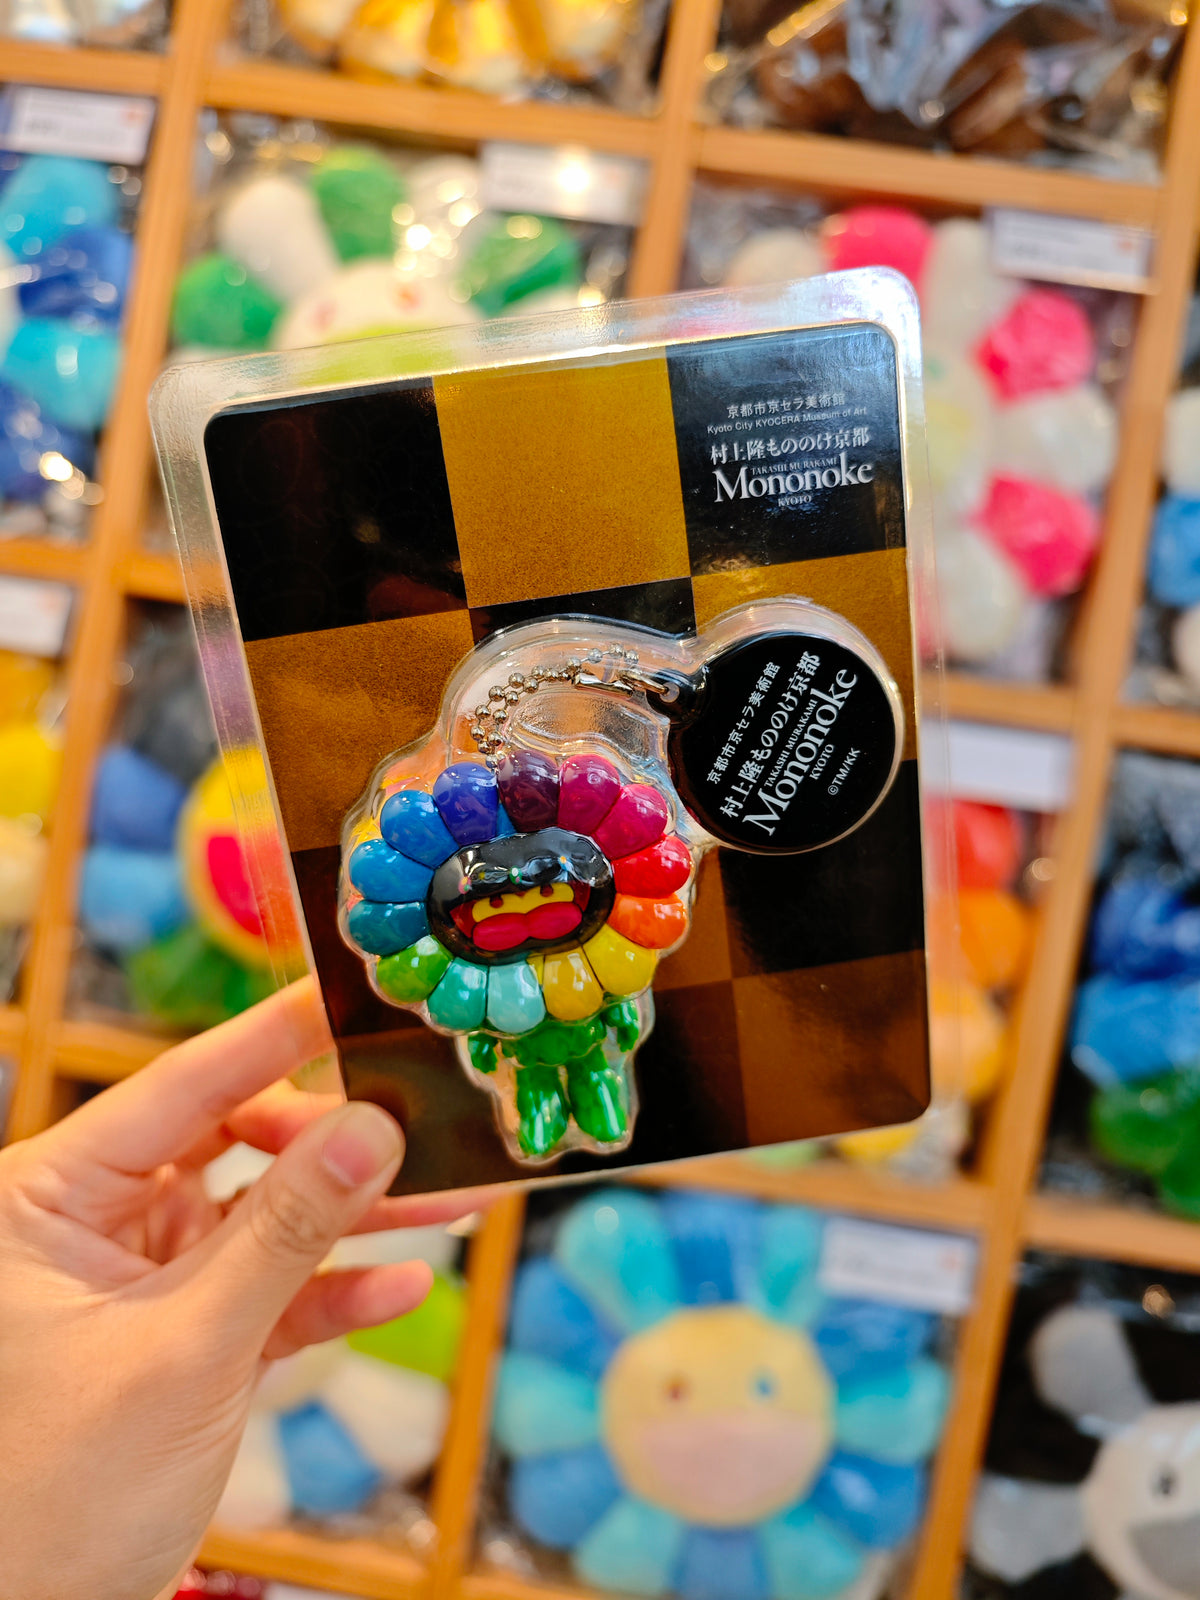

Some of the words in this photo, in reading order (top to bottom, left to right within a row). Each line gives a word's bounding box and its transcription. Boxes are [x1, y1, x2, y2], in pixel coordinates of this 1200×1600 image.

[707, 424, 733, 436] Kyoto
[735, 421, 753, 432] City
[755, 415, 800, 428] KYOCERA
[802, 411, 840, 422] Museum
[842, 409, 851, 417] of
[853, 406, 868, 416] Art
[726, 393, 846, 419] 京都市京セラ美術館
[710, 427, 871, 465] 村上隆もののけ京都
[751, 464, 787, 476] TAKASHI
[788, 457, 838, 471] MURAKAMI
[712, 451, 875, 503] Mononoke
[777, 494, 812, 507] KYOTO
[706, 661, 781, 785] 京都市京セラ美術館
[719, 650, 821, 818] 村上隆もののけ京都
[763, 750, 790, 787] TAKASHI
[788, 699, 818, 750] MURAKAMI
[742, 668, 858, 836] Mononoke
[810, 743, 834, 780] KYOTO
[827, 747, 861, 796] ©TM/KK
